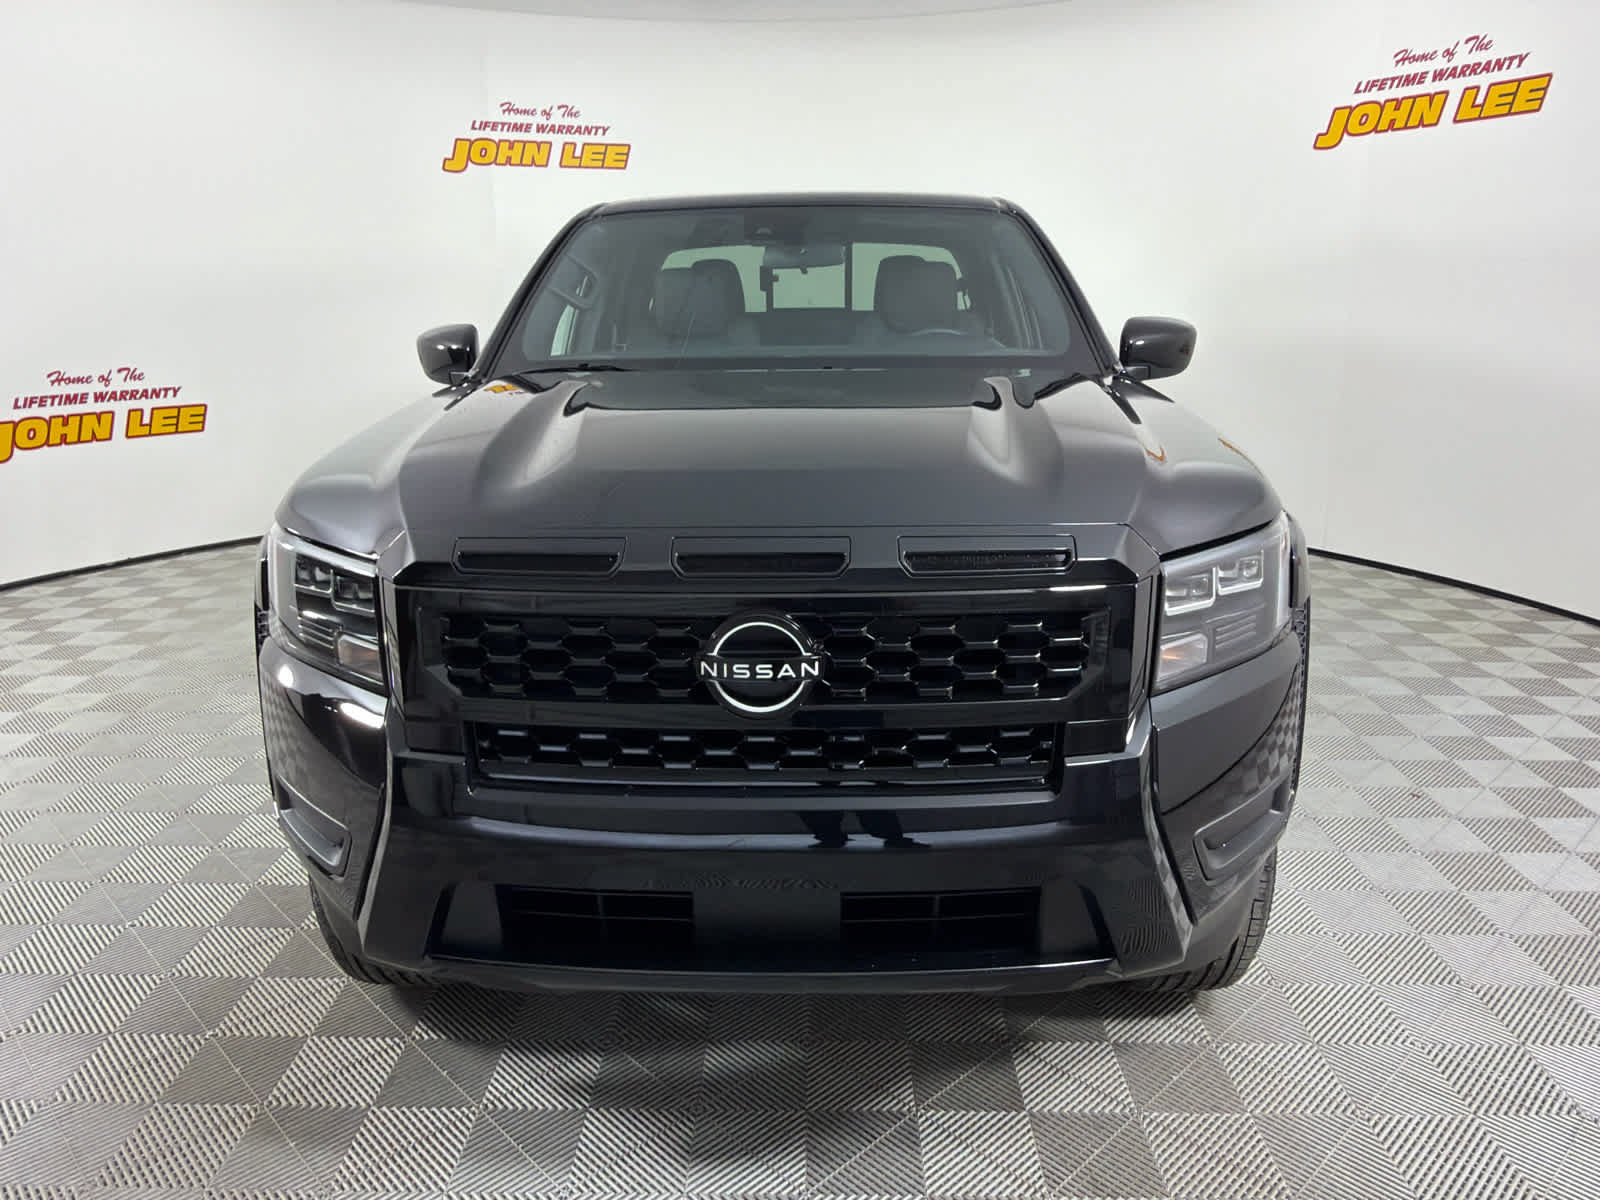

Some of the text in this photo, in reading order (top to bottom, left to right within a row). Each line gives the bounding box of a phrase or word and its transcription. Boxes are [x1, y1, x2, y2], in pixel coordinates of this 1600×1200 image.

[1393, 33, 1494, 67] Home of The
[1354, 52, 1531, 94] LIFETIME WARRANTY
[500, 102, 581, 120] Home of The
[1313, 72, 1553, 150] JOHN LEE
[471, 120, 611, 136] LIFETIME WARRANTY
[442, 138, 631, 173] JOHN LEE
[47, 367, 144, 387] Home of The
[13, 386, 182, 409] LIFETIME WARRANTY
[125, 404, 207, 438] LEE
[700, 660, 820, 679] NISSAN
